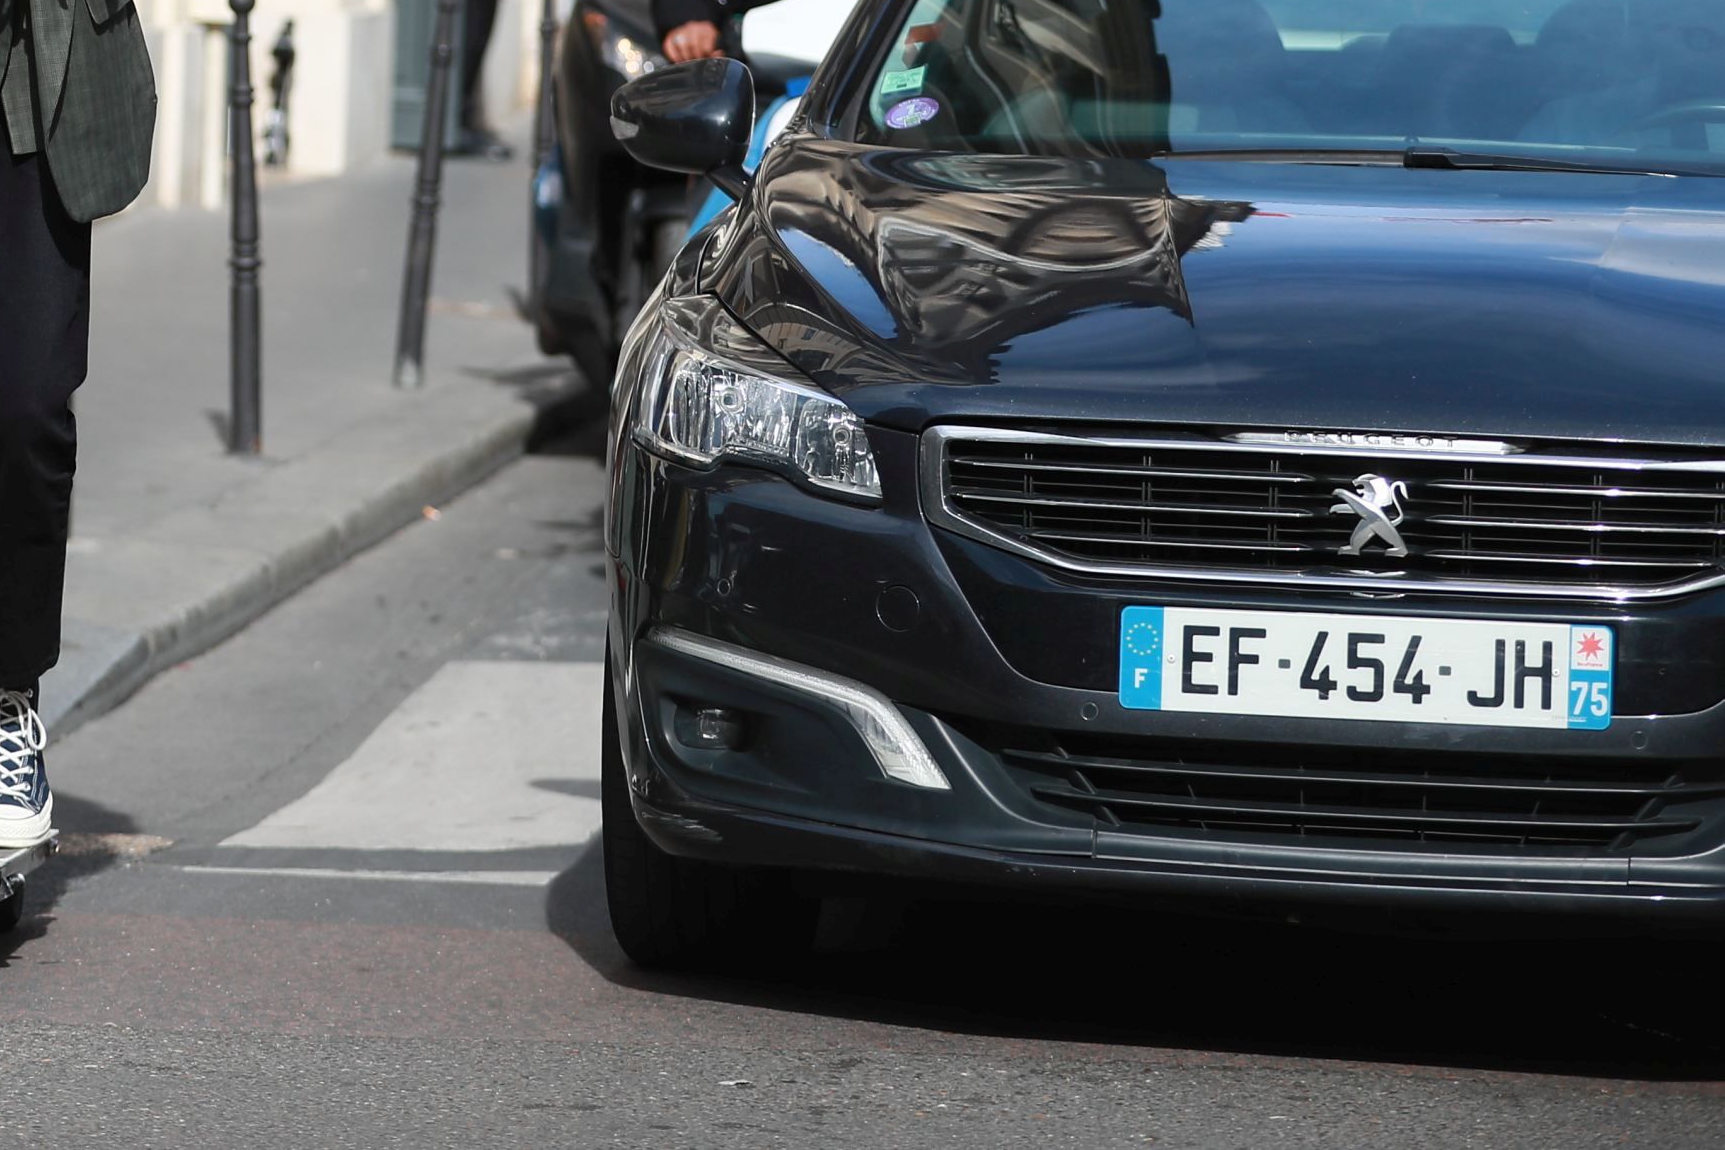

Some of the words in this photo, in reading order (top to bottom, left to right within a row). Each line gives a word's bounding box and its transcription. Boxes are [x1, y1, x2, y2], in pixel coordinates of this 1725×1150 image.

[1283, 430, 1459, 448] PEUGEOT
[1133, 668, 1148, 689] F
[1570, 681, 1608, 717] 75
